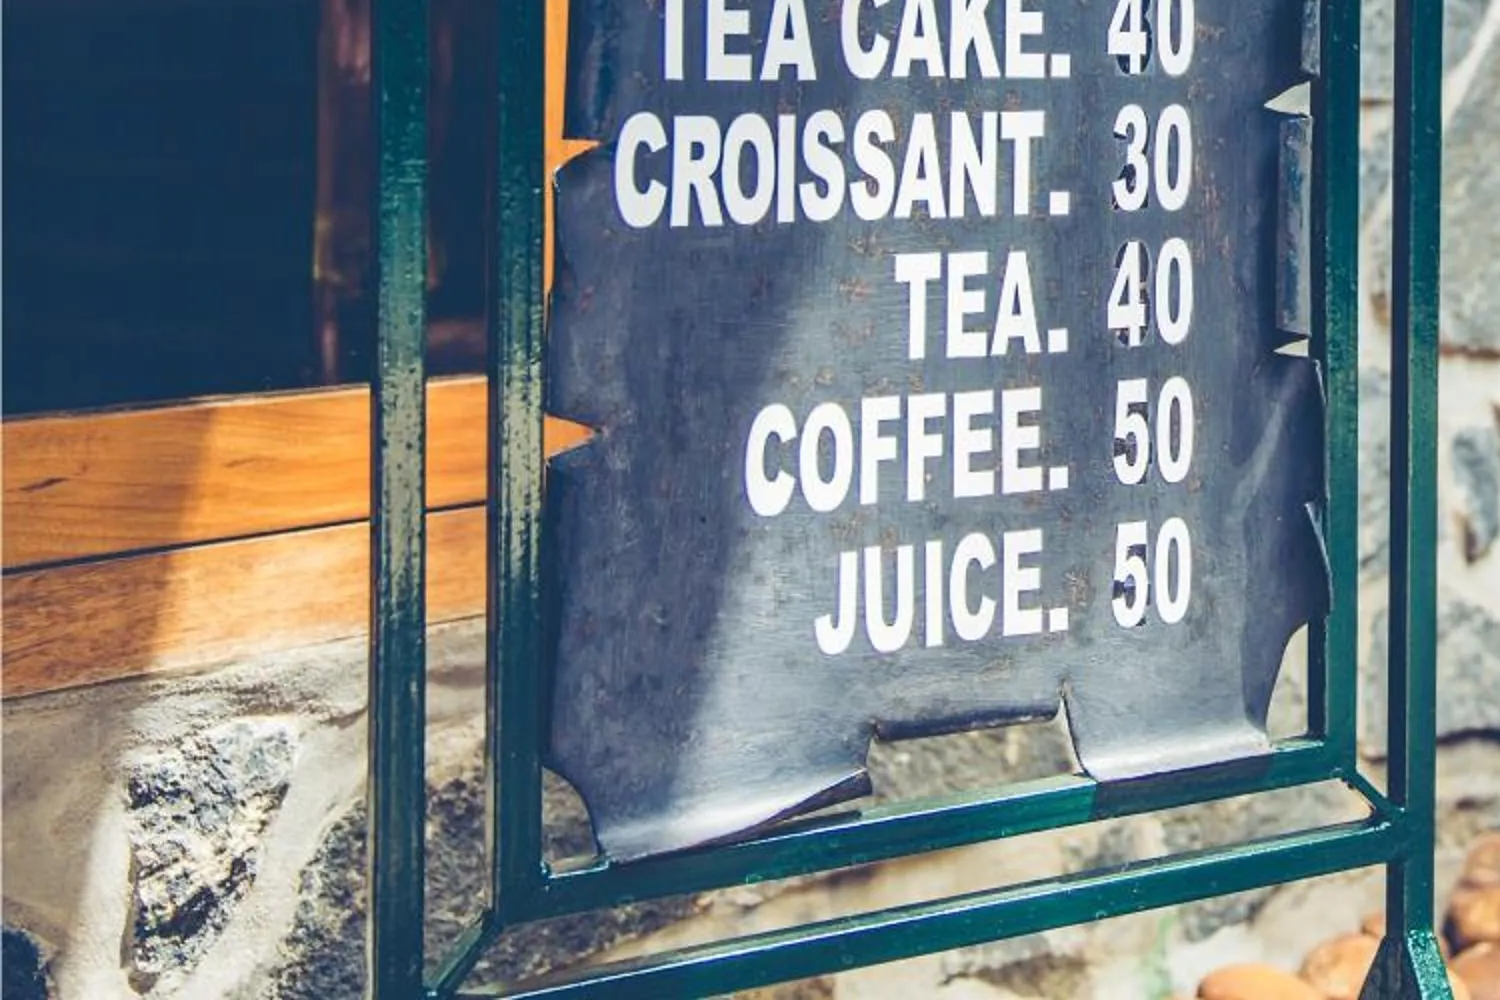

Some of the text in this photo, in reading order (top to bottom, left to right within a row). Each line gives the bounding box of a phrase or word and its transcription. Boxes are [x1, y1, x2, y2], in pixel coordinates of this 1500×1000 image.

[615, 103, 1193, 228] CROISSANT. 30
[895, 237, 1193, 360] TEA. 40
[745, 376, 1193, 516] COFFEE. 50
[814, 517, 1193, 655] JUICE. 50
